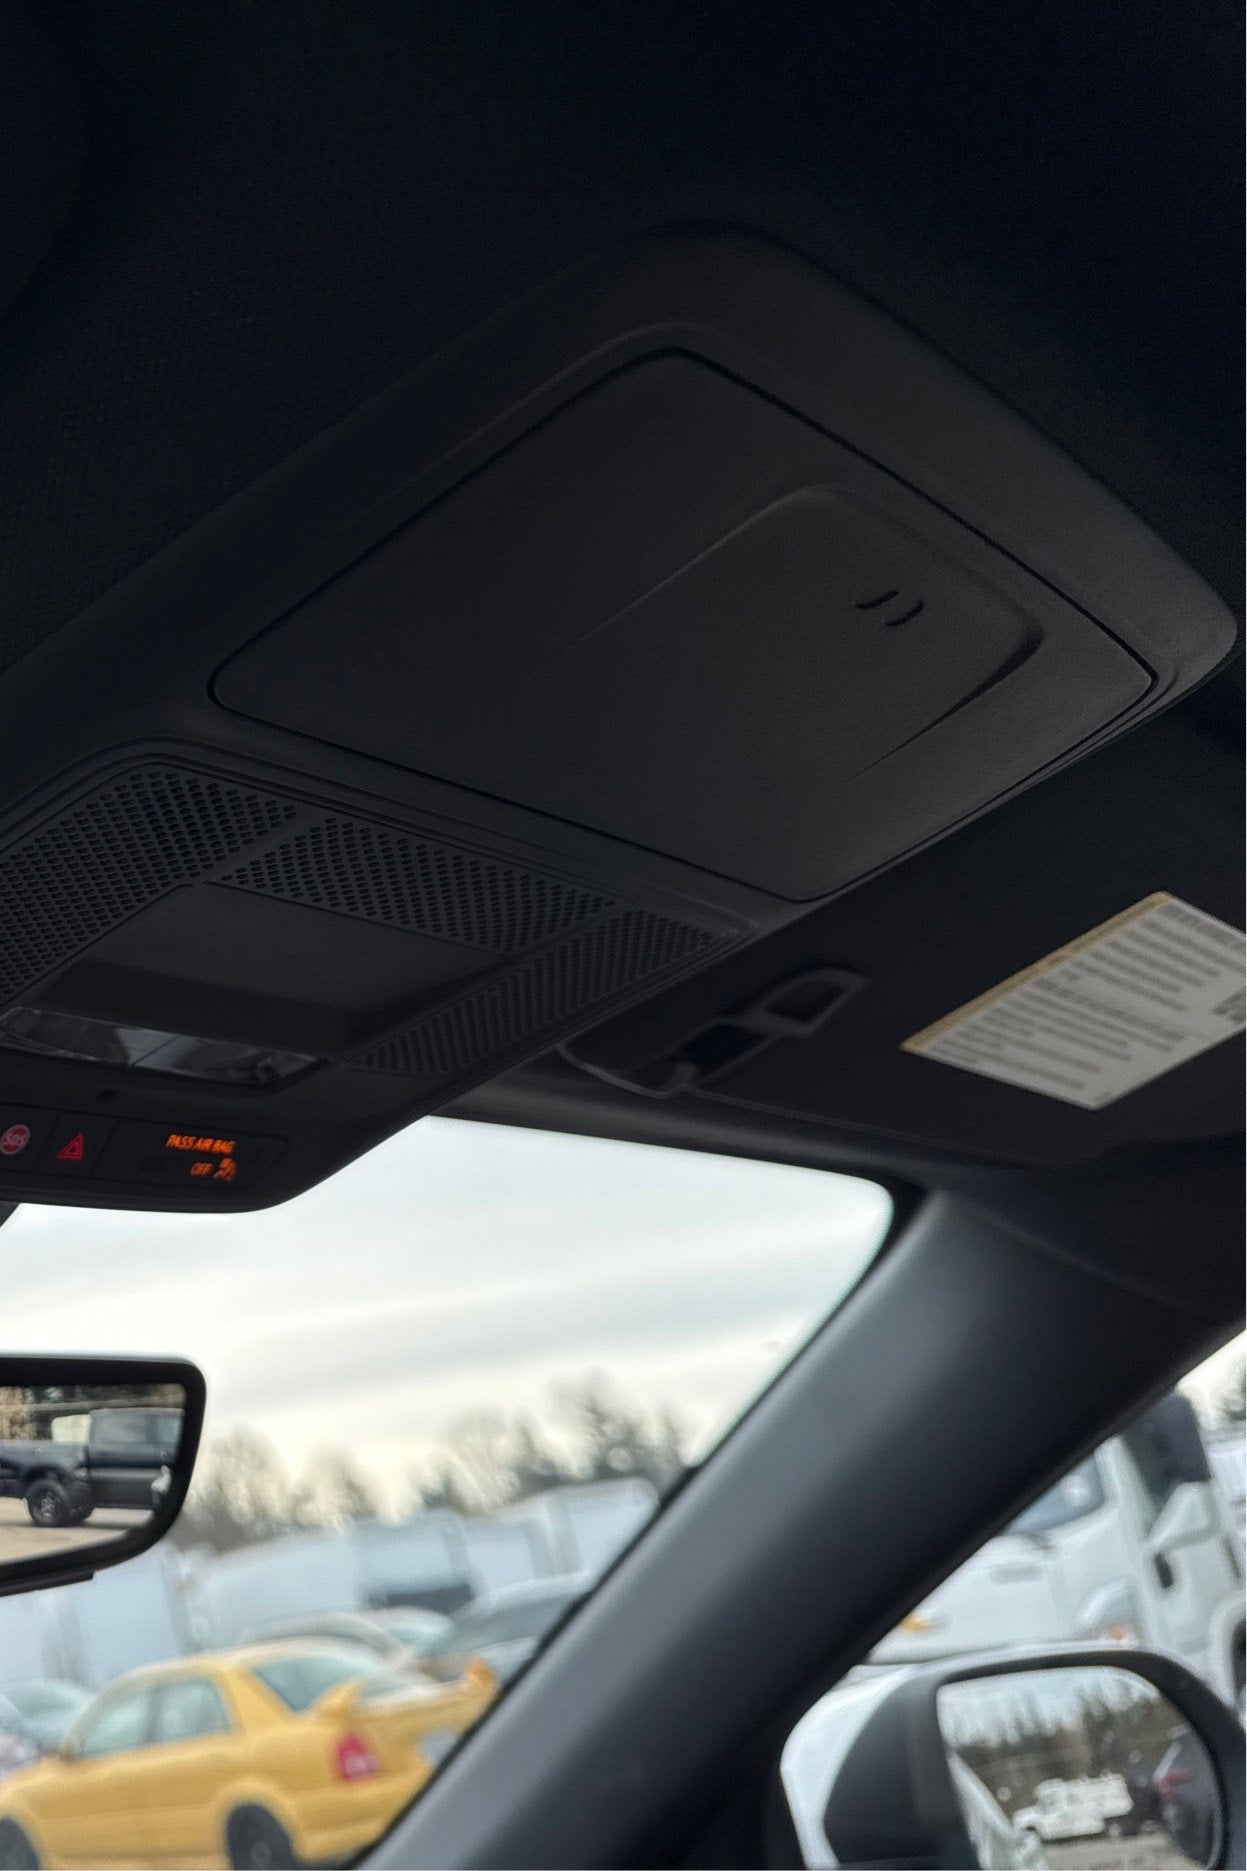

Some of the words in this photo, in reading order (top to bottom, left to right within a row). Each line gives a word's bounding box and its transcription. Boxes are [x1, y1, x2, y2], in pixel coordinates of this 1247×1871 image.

[165, 1134, 196, 1151] PASS
[195, 1137, 214, 1153] AIR
[212, 1139, 236, 1155] BAG
[190, 1162, 213, 1177] OFF
